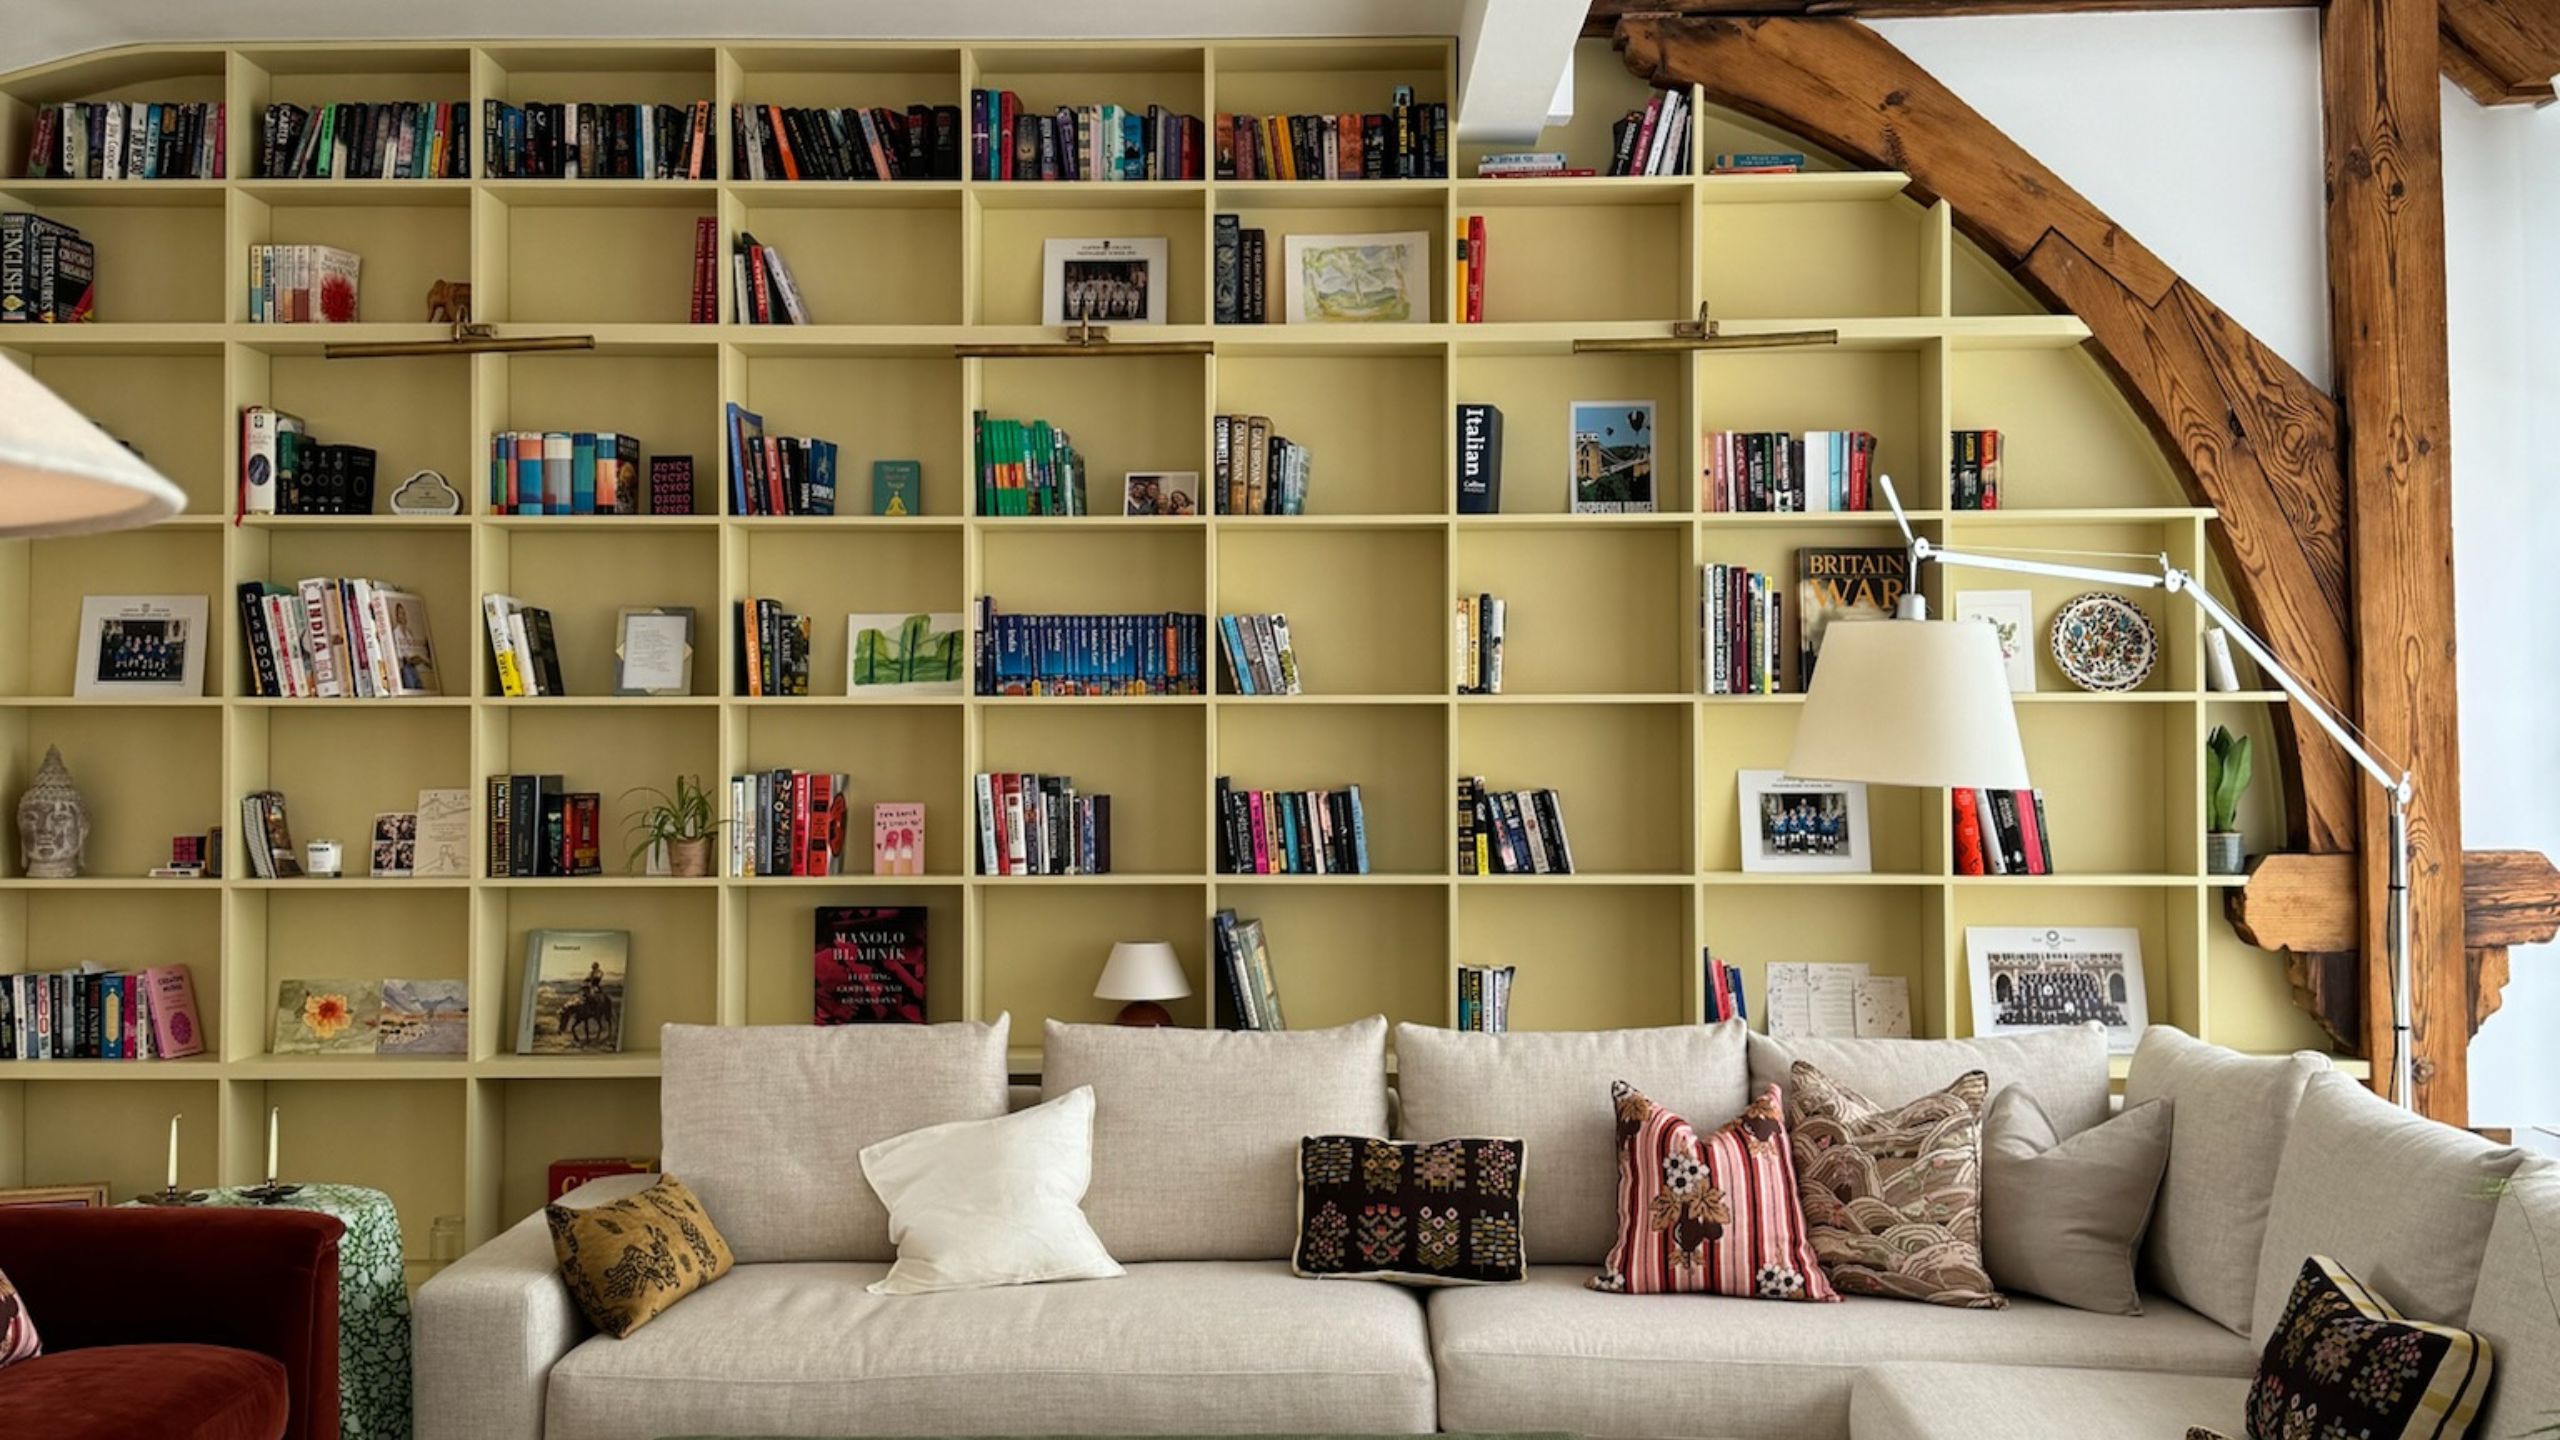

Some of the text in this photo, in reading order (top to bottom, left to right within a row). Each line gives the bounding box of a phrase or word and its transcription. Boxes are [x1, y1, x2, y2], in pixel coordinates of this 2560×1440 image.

[107, 139, 119, 170] Cooper
[3, 229, 24, 294] ENGLISH
[1233, 423, 1244, 481] DAN BROWN
[1251, 428, 1263, 448] DAN
[1465, 408, 1484, 477] Italian
[1809, 554, 1904, 575] BRITAIN
[1809, 578, 1904, 610] WAR
[246, 592, 275, 682] DISHOOM
[307, 598, 327, 654] INDIA
[1007, 629, 1018, 653] India
[835, 931, 905, 944] MANOLO
